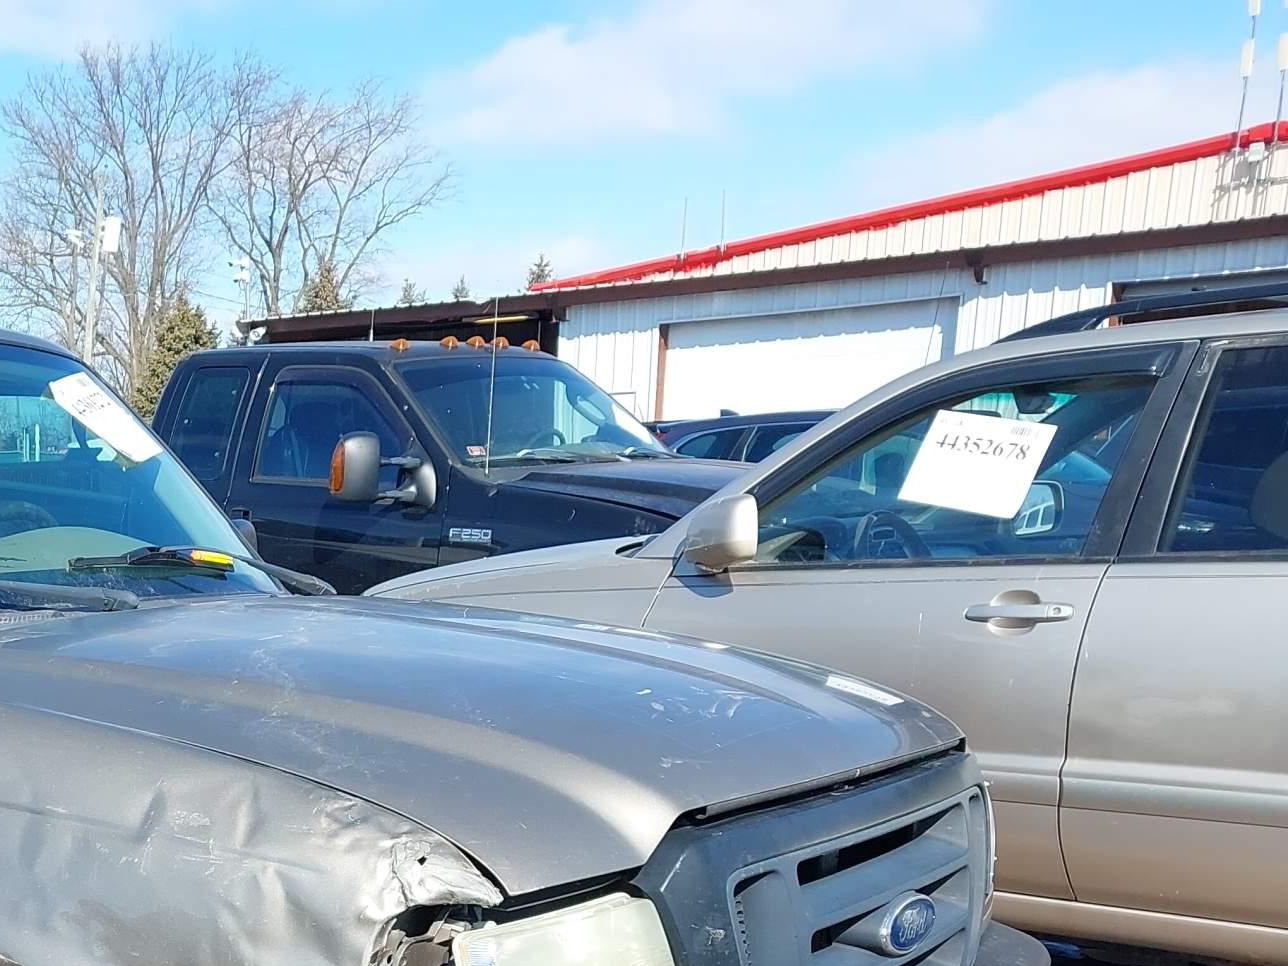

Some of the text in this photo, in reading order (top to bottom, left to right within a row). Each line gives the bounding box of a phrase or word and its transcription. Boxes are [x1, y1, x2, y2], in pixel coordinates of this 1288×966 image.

[936, 433, 1031, 460] 44352678
[449, 527, 492, 540] F250
[899, 907, 928, 942] Ford
